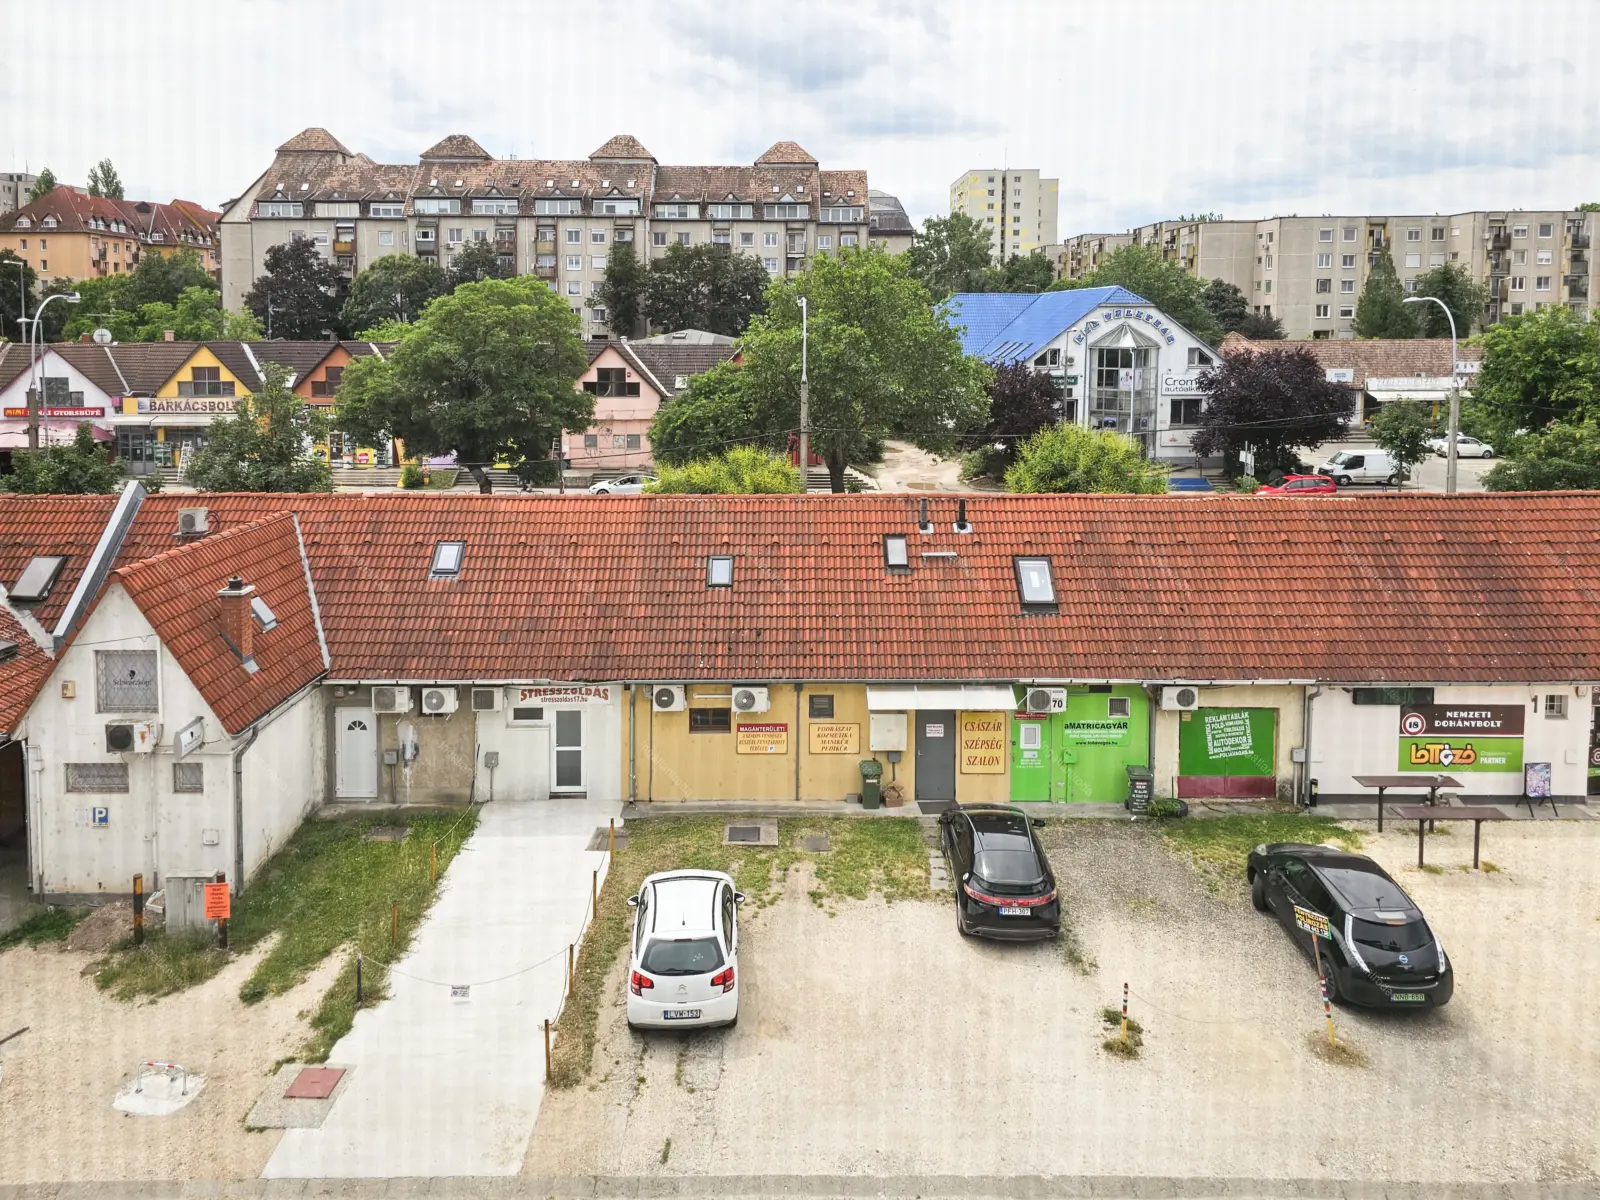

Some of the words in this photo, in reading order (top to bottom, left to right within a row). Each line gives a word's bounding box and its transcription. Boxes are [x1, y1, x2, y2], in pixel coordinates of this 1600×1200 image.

[520, 686, 609, 702] STRESSZOLDÁS
[1052, 700, 1063, 708] 70
[964, 719, 1002, 731] CSÁSZÁR
[1064, 721, 1128, 730] aMATRICAGYÁR
[1434, 719, 1503, 728] DOHÁNYBOLT
[963, 737, 1002, 750] SZÉPSÉG
[966, 755, 1001, 766] SZALON
[95, 808, 106, 823] P
